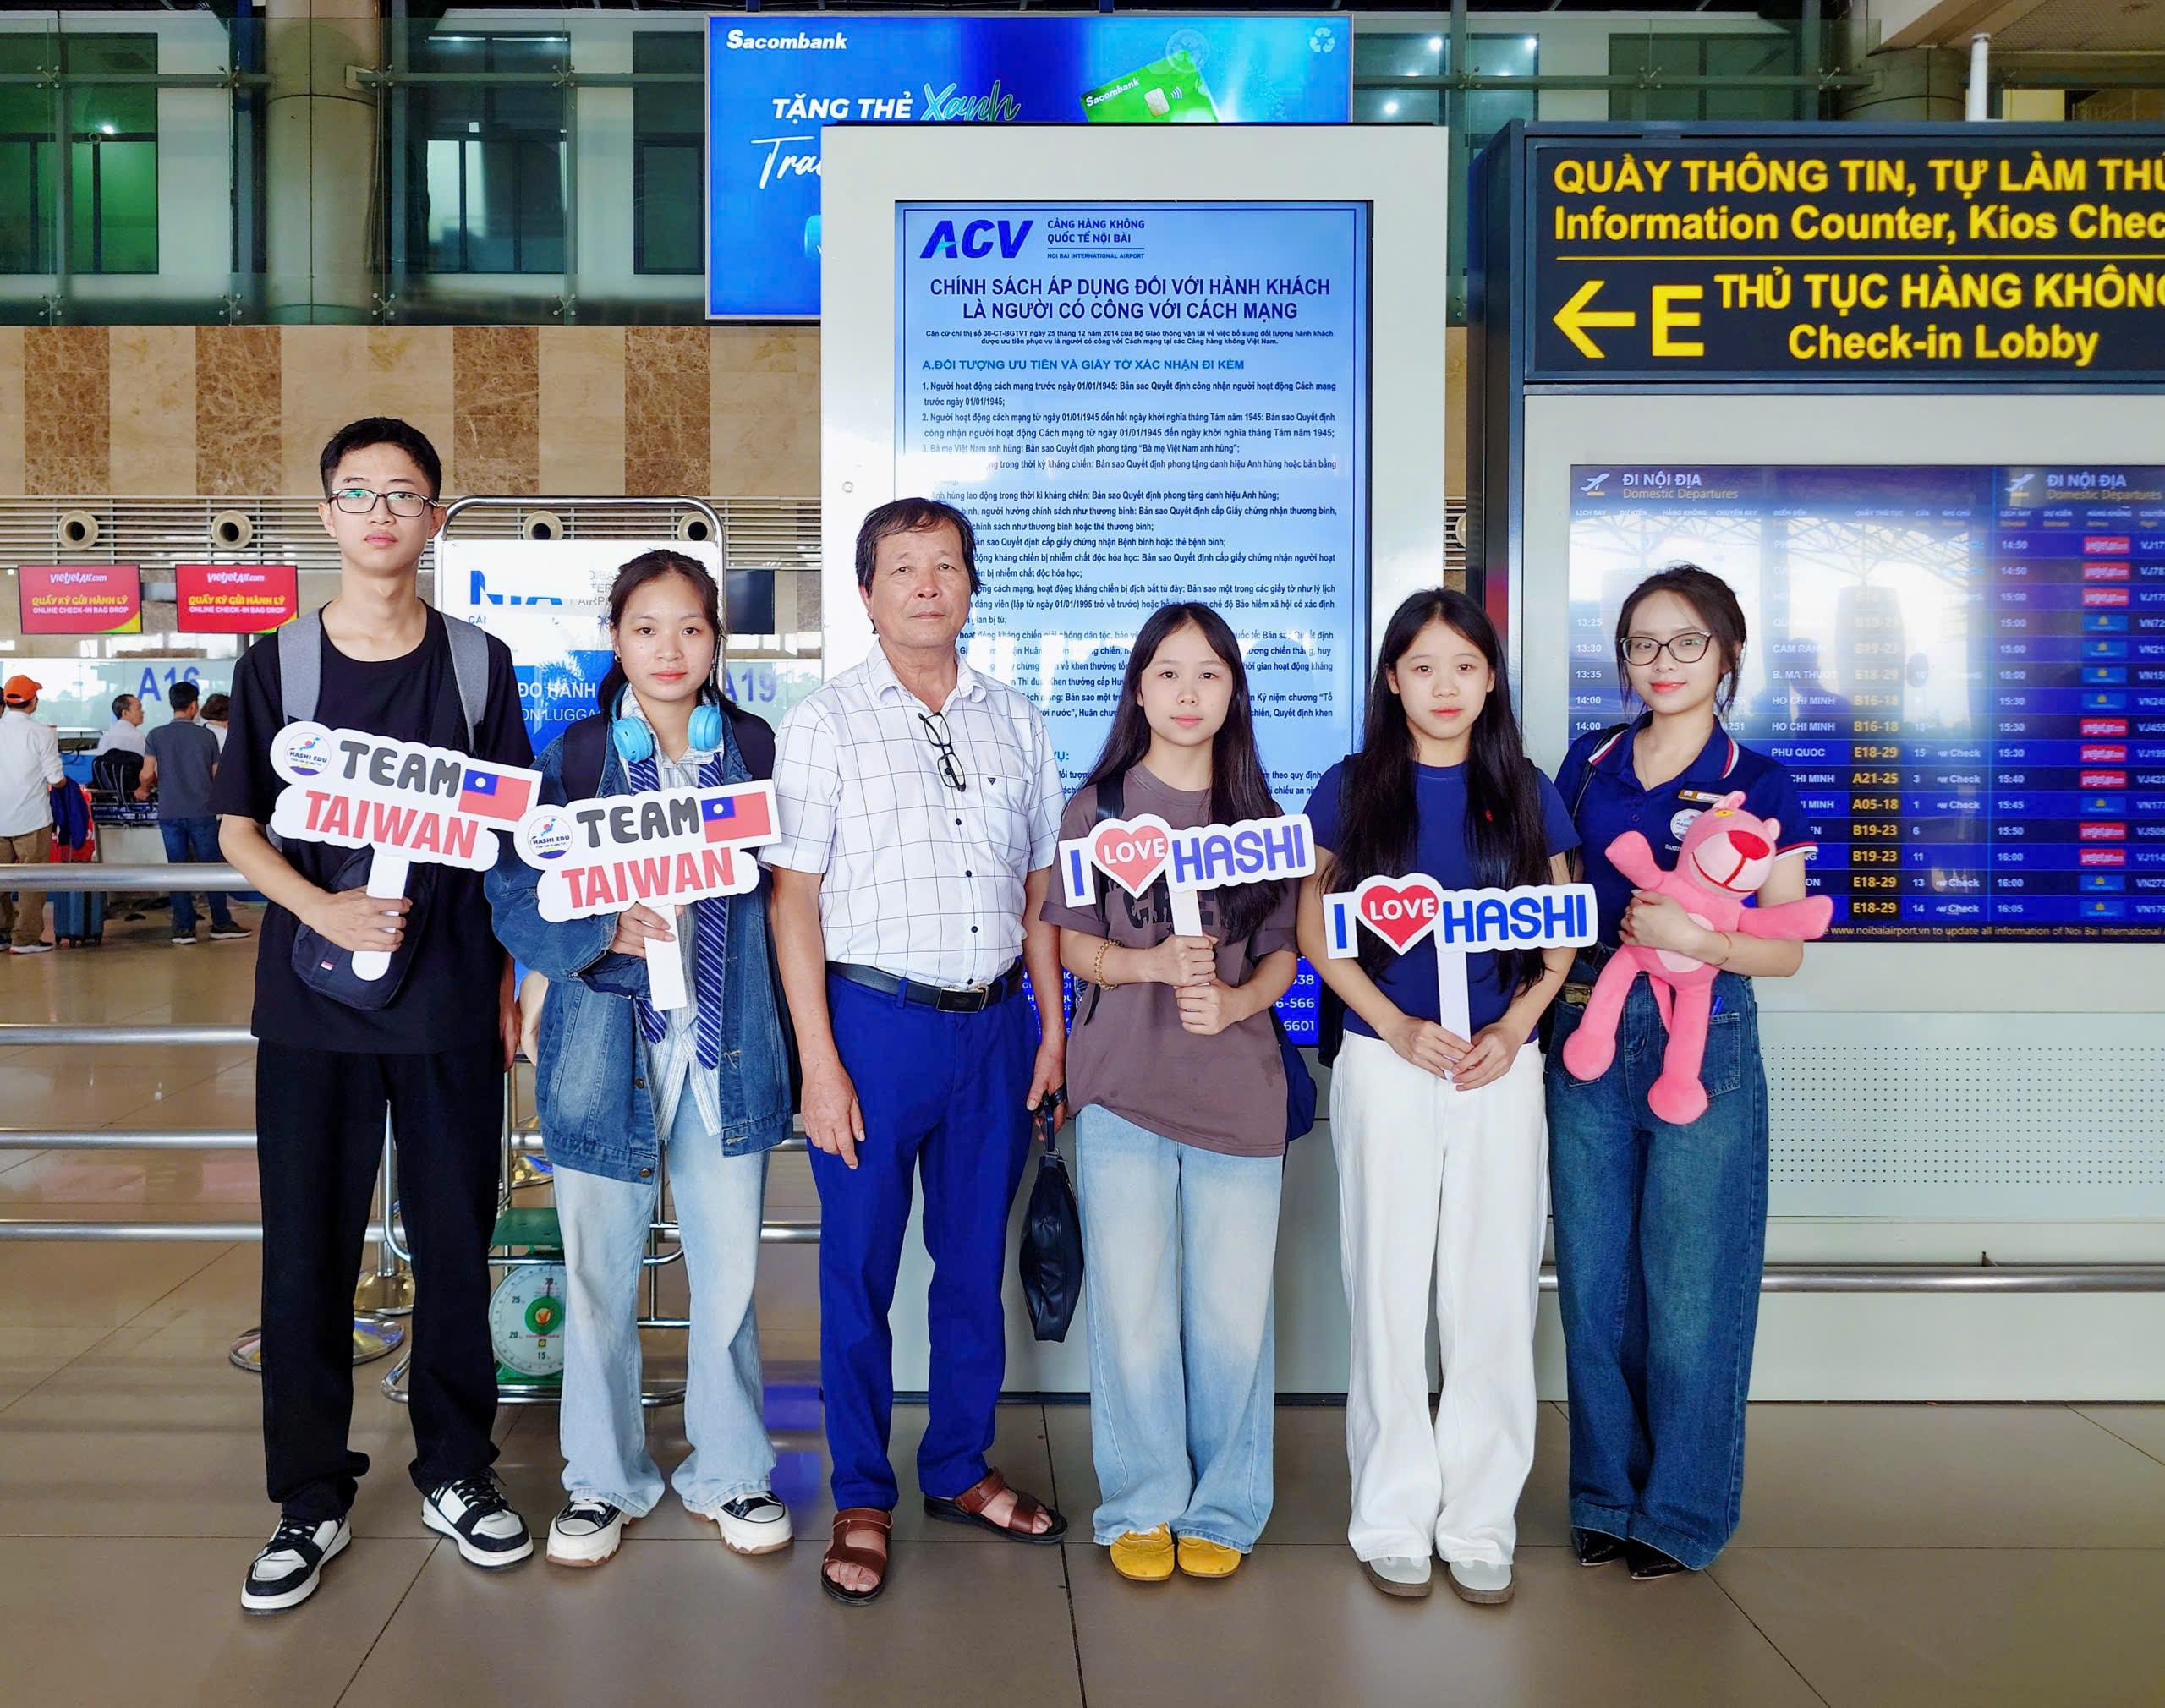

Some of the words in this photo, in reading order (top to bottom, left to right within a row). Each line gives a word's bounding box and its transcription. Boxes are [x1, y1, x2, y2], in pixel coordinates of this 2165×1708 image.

[726, 29, 847, 49] Sacombank
[1085, 79, 1139, 107] Sacombank
[772, 93, 850, 124] TẶNG
[858, 91, 913, 119] THẺ
[921, 80, 1021, 121] Xanh
[1554, 153, 1671, 194] QUẦY
[1681, 152, 1828, 193] THÔNG
[1839, 160, 1916, 197] TIN,
[1928, 160, 1989, 200] TỰ
[1999, 151, 2086, 191] LÀM
[1048, 217, 1075, 228] CẢNG
[1078, 218, 1106, 228] HÀNG
[1110, 218, 1144, 228] KHÔNG
[1555, 205, 1779, 240] Information
[1791, 205, 1956, 245] Counter,
[1970, 205, 2057, 239] Kios
[920, 220, 1033, 259] ACV
[1048, 231, 1075, 244] QUỐC
[1077, 231, 1090, 243] TẾ
[1093, 233, 1110, 244] NỘI
[1114, 233, 1131, 243] BÀI
[930, 275, 985, 295] CHÍNH
[992, 275, 1042, 295] SÁCH
[1047, 275, 1072, 295] ÁP
[1078, 279, 1129, 298] DỤNG
[1171, 275, 1203, 295] VỚI
[1210, 275, 1260, 295] HÀNH
[1267, 275, 1329, 295] KHÁCH
[1713, 266, 1791, 309] THỦ
[1803, 273, 1888, 316] TỤC
[1901, 265, 2021, 308] HÀNG
[2035, 265, 2165, 308] KHÔN
[963, 299, 986, 319] LÀ
[992, 299, 1053, 319] NGƯỜI
[1059, 299, 1085, 319] CÓ
[1091, 299, 1143, 319] CÔNG
[1148, 299, 1181, 319] VỚI
[1187, 299, 1237, 319] CÁCH
[1244, 303, 1297, 322] MẠNG
[1652, 285, 1704, 357] E
[1789, 324, 1962, 359] Check-in
[1976, 324, 2098, 366] Lobby
[959, 360, 1005, 371] TƯỢNG
[1009, 360, 1027, 370] ƯU
[1030, 359, 1057, 370] TIÊN
[1061, 359, 1078, 370] VÀ
[1114, 359, 1132, 370] TỜ
[1135, 359, 1160, 370] XÁC
[1202, 360, 1214, 369] ĐI
[1218, 359, 1244, 370] KÈM
[924, 397, 945, 406] trước
[946, 397, 964, 408] ngày
[924, 429, 944, 439] công
[946, 429, 967, 438] nhận
[969, 429, 994, 439] người
[996, 429, 1014, 439] hoạt
[1016, 429, 1036, 439] động
[1039, 429, 1060, 437] Cách
[1061, 430, 1084, 439] mạng
[1098, 428, 1117, 439] ngày
[1120, 428, 1162, 436] 01/01/1945
[1181, 428, 1201, 439] ngày
[1248, 428, 1271, 439] tháng
[1623, 474, 1638, 486] ĐI
[1644, 472, 1671, 488] NỘI
[1674, 474, 1702, 488] ĐỊA
[2047, 474, 2063, 487] ĐI
[2067, 473, 2096, 490] NỘI
[2098, 474, 2126, 490] ĐỊA
[1623, 488, 1674, 500] Domestic
[1678, 489, 1738, 501] Departures
[2047, 489, 2098, 500] Domestic
[1576, 670, 1602, 678] 13:35
[1576, 696, 1601, 704] 14:00
[1772, 697, 1787, 705] HO
[1809, 697, 1834, 705] MINH
[1576, 722, 1601, 731] 14:00
[1772, 723, 1787, 731] HO
[1790, 723, 1806, 731] CHI
[1809, 723, 1834, 731] MINH
[289, 750, 312, 760] HASHI
[313, 755, 328, 764] EDU
[1772, 748, 1792, 758] PHU
[1795, 748, 1825, 758] QUOC
[1855, 747, 1898, 758] E18-29
[340, 740, 461, 798] TEAM
[1853, 774, 1899, 784] A21-25
[1853, 799, 1899, 810] A05-18
[305, 790, 479, 858] TAIWAN
[577, 797, 699, 848] TEAM
[1853, 825, 1897, 836] B19-23
[532, 836, 555, 846] HASHI
[1070, 850, 1085, 896] I
[1103, 838, 1165, 864] LOVE
[1172, 824, 1306, 883] HASHI
[1853, 851, 1897, 862] B19-23
[562, 847, 735, 909] TAIWAN
[1854, 877, 1896, 888] E18-29
[1854, 903, 1896, 914] E18-29
[1334, 903, 1347, 949] I
[1369, 899, 1435, 921] LOVE
[1444, 894, 1587, 944] HASHI
[1831, 927, 1930, 937] www.noibaiairport.vn
[1932, 928, 1943, 936] to
[1945, 928, 1979, 937] update
[1994, 927, 2049, 936] information
[2053, 927, 2063, 935] of
[1273, 998, 1315, 1009] 6-566
